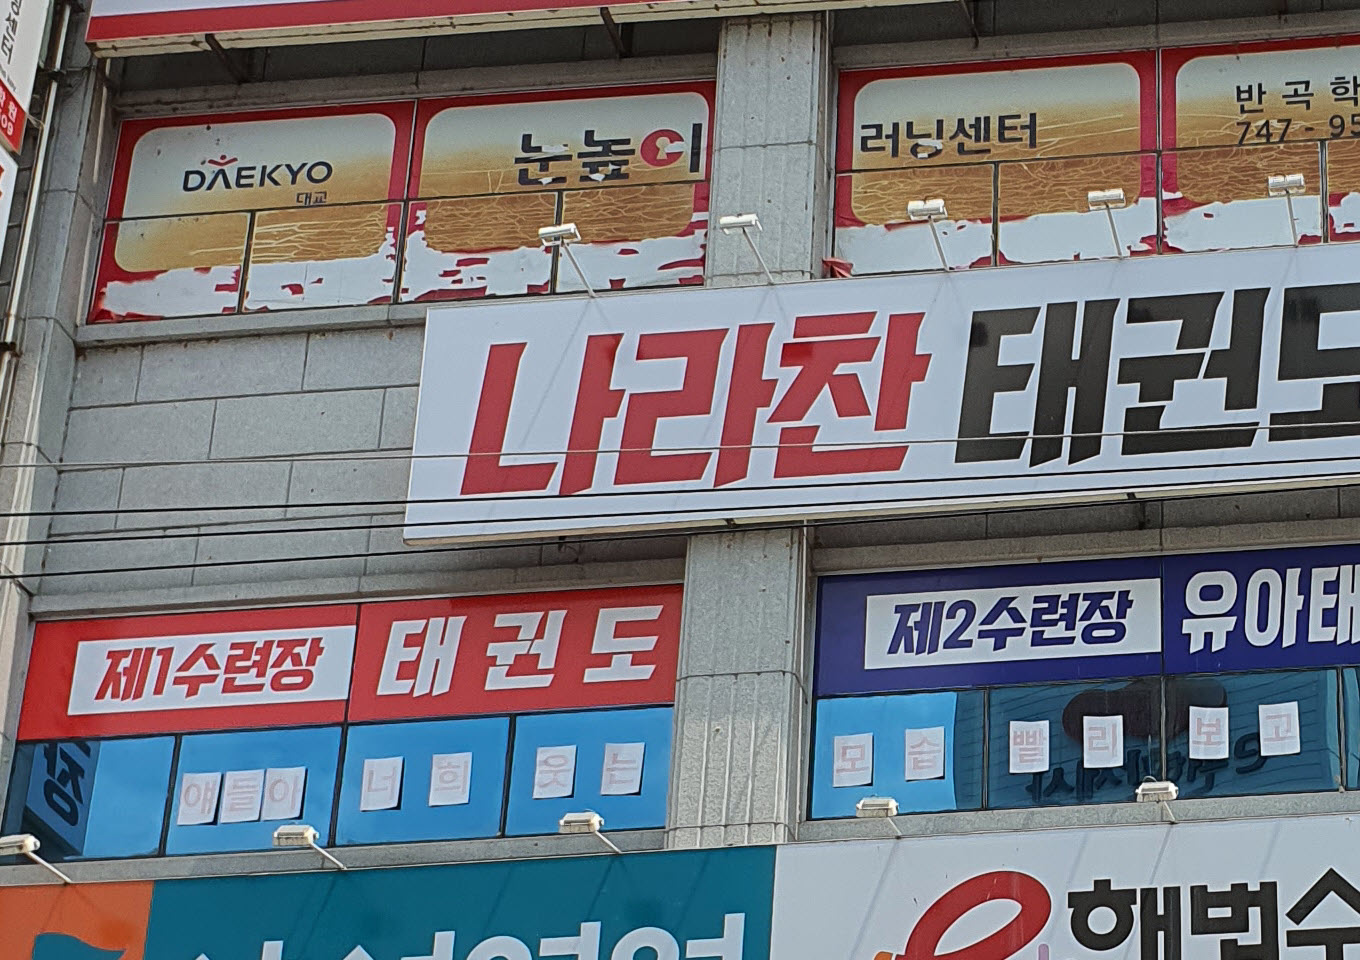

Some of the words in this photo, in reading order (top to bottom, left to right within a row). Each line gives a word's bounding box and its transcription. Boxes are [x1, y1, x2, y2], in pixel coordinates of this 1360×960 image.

[515, 123, 702, 187] 눈높이
[860, 112, 1038, 160] 러닝센터
[182, 154, 332, 193] DAEKYO
[295, 190, 327, 206] 대교
[460, 311, 931, 495] 나라찬
[95, 637, 324, 701] 제1수련장
[377, 606, 663, 697] 태권도
[888, 590, 1133, 656] 제2수련장
